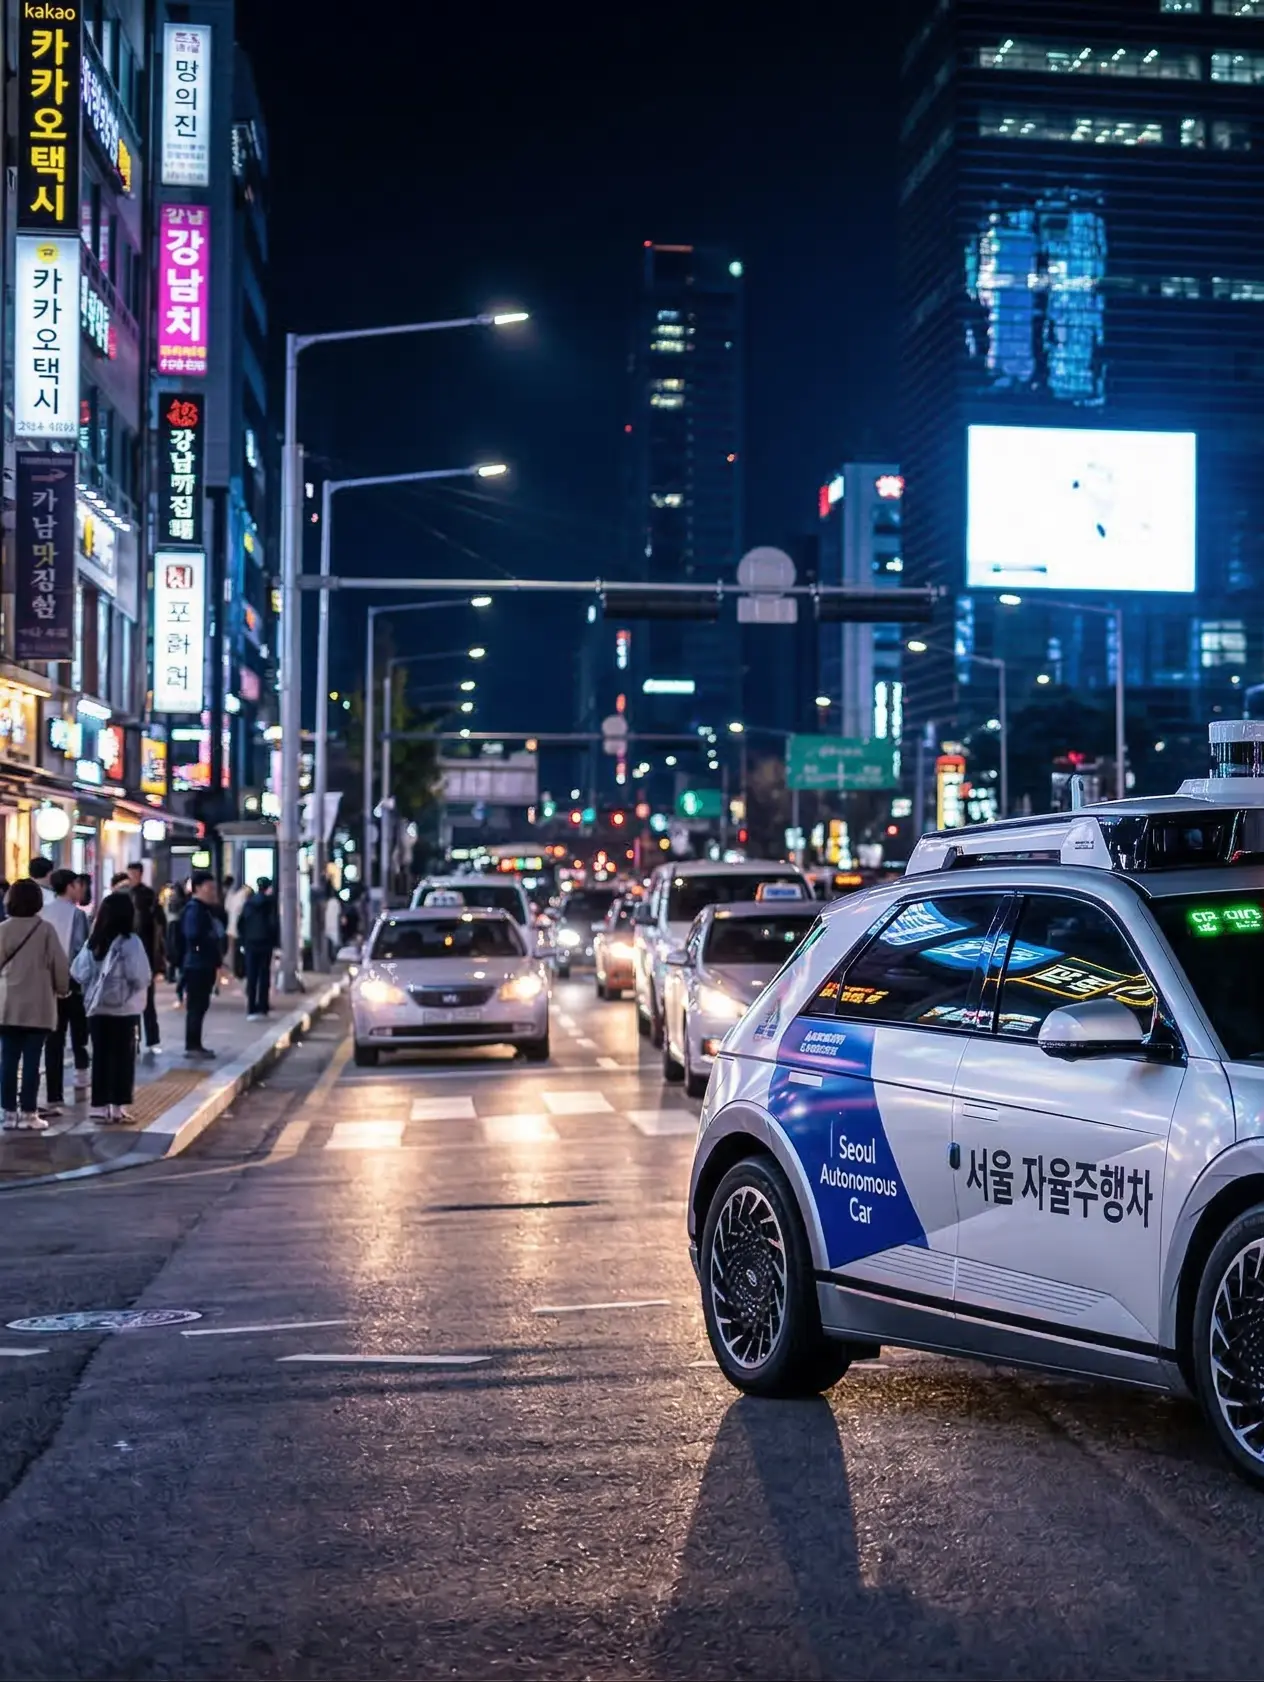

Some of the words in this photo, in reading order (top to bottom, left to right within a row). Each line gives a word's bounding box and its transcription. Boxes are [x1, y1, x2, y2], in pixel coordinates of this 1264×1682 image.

[24, 2, 76, 20] kakao
[30, 28, 69, 222] 카카오택시
[165, 229, 204, 342] 강남치
[33, 268, 62, 414] 카카오택시
[839, 1136, 876, 1165] Seoul
[820, 1163, 897, 1198] Autonomous
[966, 1148, 1014, 1206] 서울
[1021, 1154, 1154, 1228] 자율주행차
[849, 1196, 873, 1225] Car
